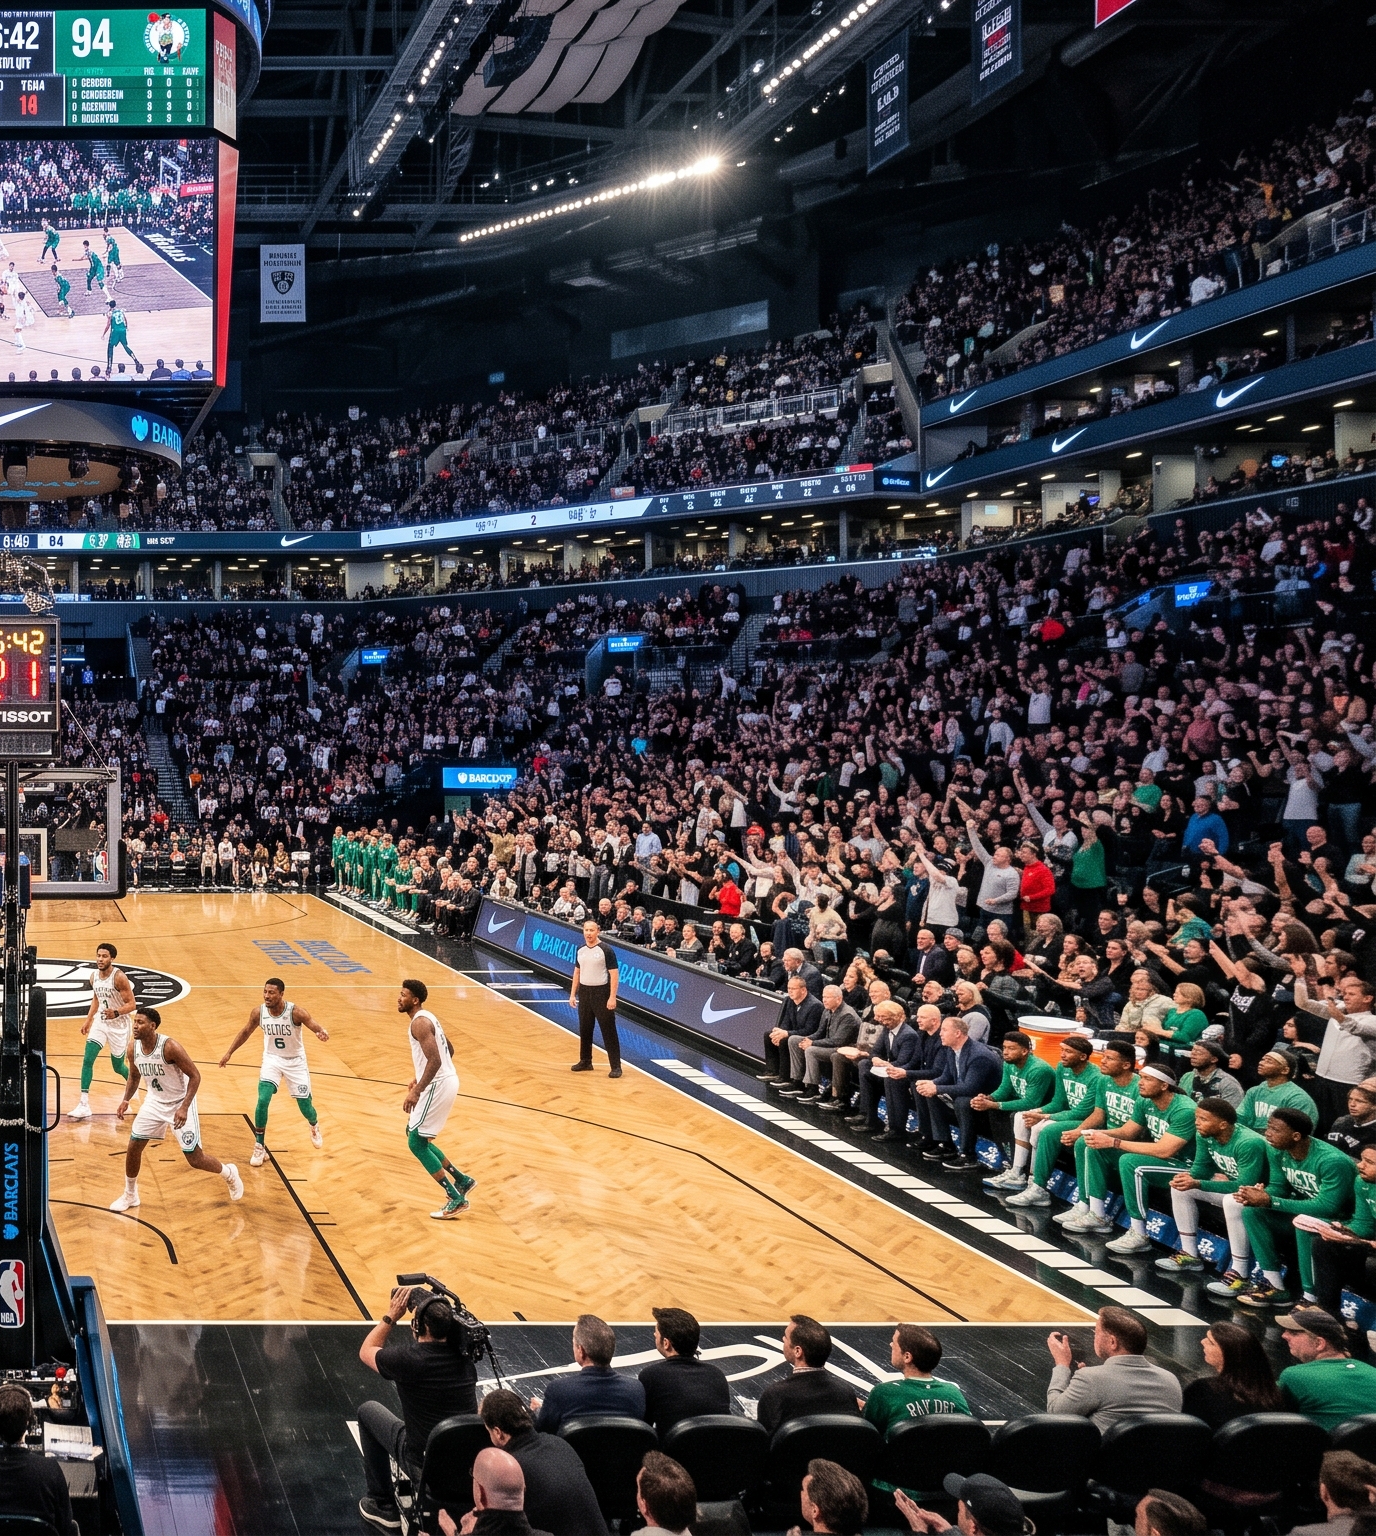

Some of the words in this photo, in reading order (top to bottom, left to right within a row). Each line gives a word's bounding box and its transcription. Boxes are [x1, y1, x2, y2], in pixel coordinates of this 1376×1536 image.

[71, 18, 113, 57] 94
[541, 934, 577, 964] BARCLA
[620, 962, 680, 1005] BARCLAYS
[274, 1038, 286, 1049] 6
[3, 1142, 19, 1221] BARCLAYS
[0, 1312, 15, 1324] NBA
